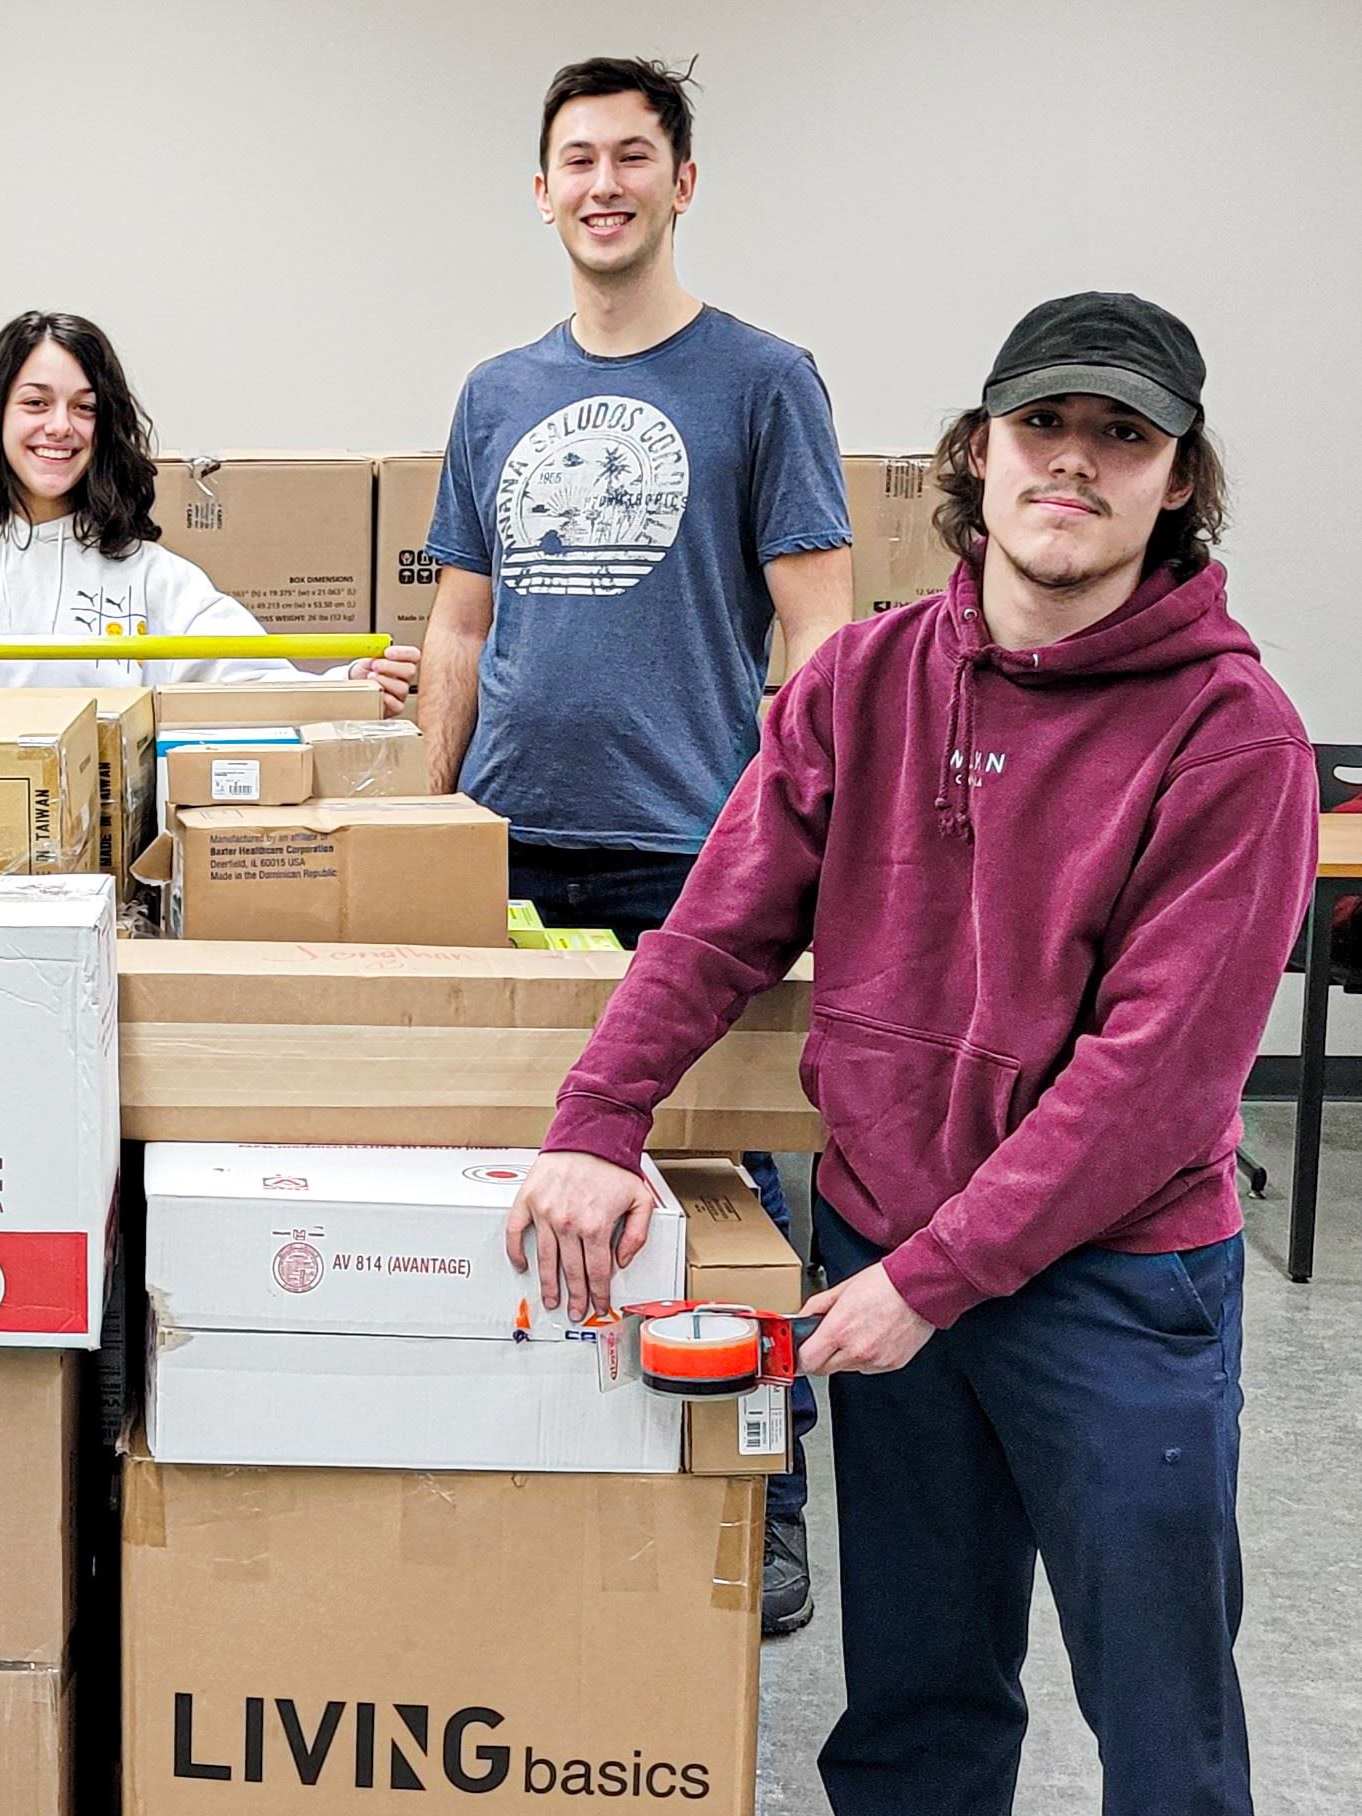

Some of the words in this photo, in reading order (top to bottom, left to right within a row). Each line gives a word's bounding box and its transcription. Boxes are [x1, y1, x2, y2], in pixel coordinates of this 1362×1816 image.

[34, 789, 50, 841] TAIWAN
[100, 833, 113, 867] MADE
[210, 847, 237, 856] Baxter
[239, 845, 284, 856] Healthcare
[286, 844, 334, 855] Corporation
[210, 859, 249, 869] Deerfield,
[260, 858, 286, 867] 60015
[288, 857, 306, 867] USA
[210, 871, 233, 880] Made
[244, 870, 257, 880] the
[259, 869, 302, 879] Dominican
[303, 868, 337, 879] Republic
[332, 1253, 352, 1271] AV
[356, 1254, 383, 1272] 814
[387, 1255, 472, 1278] (AVANTAGE)
[172, 1691, 511, 1795] LIVING
[524, 1748, 711, 1801] basics
